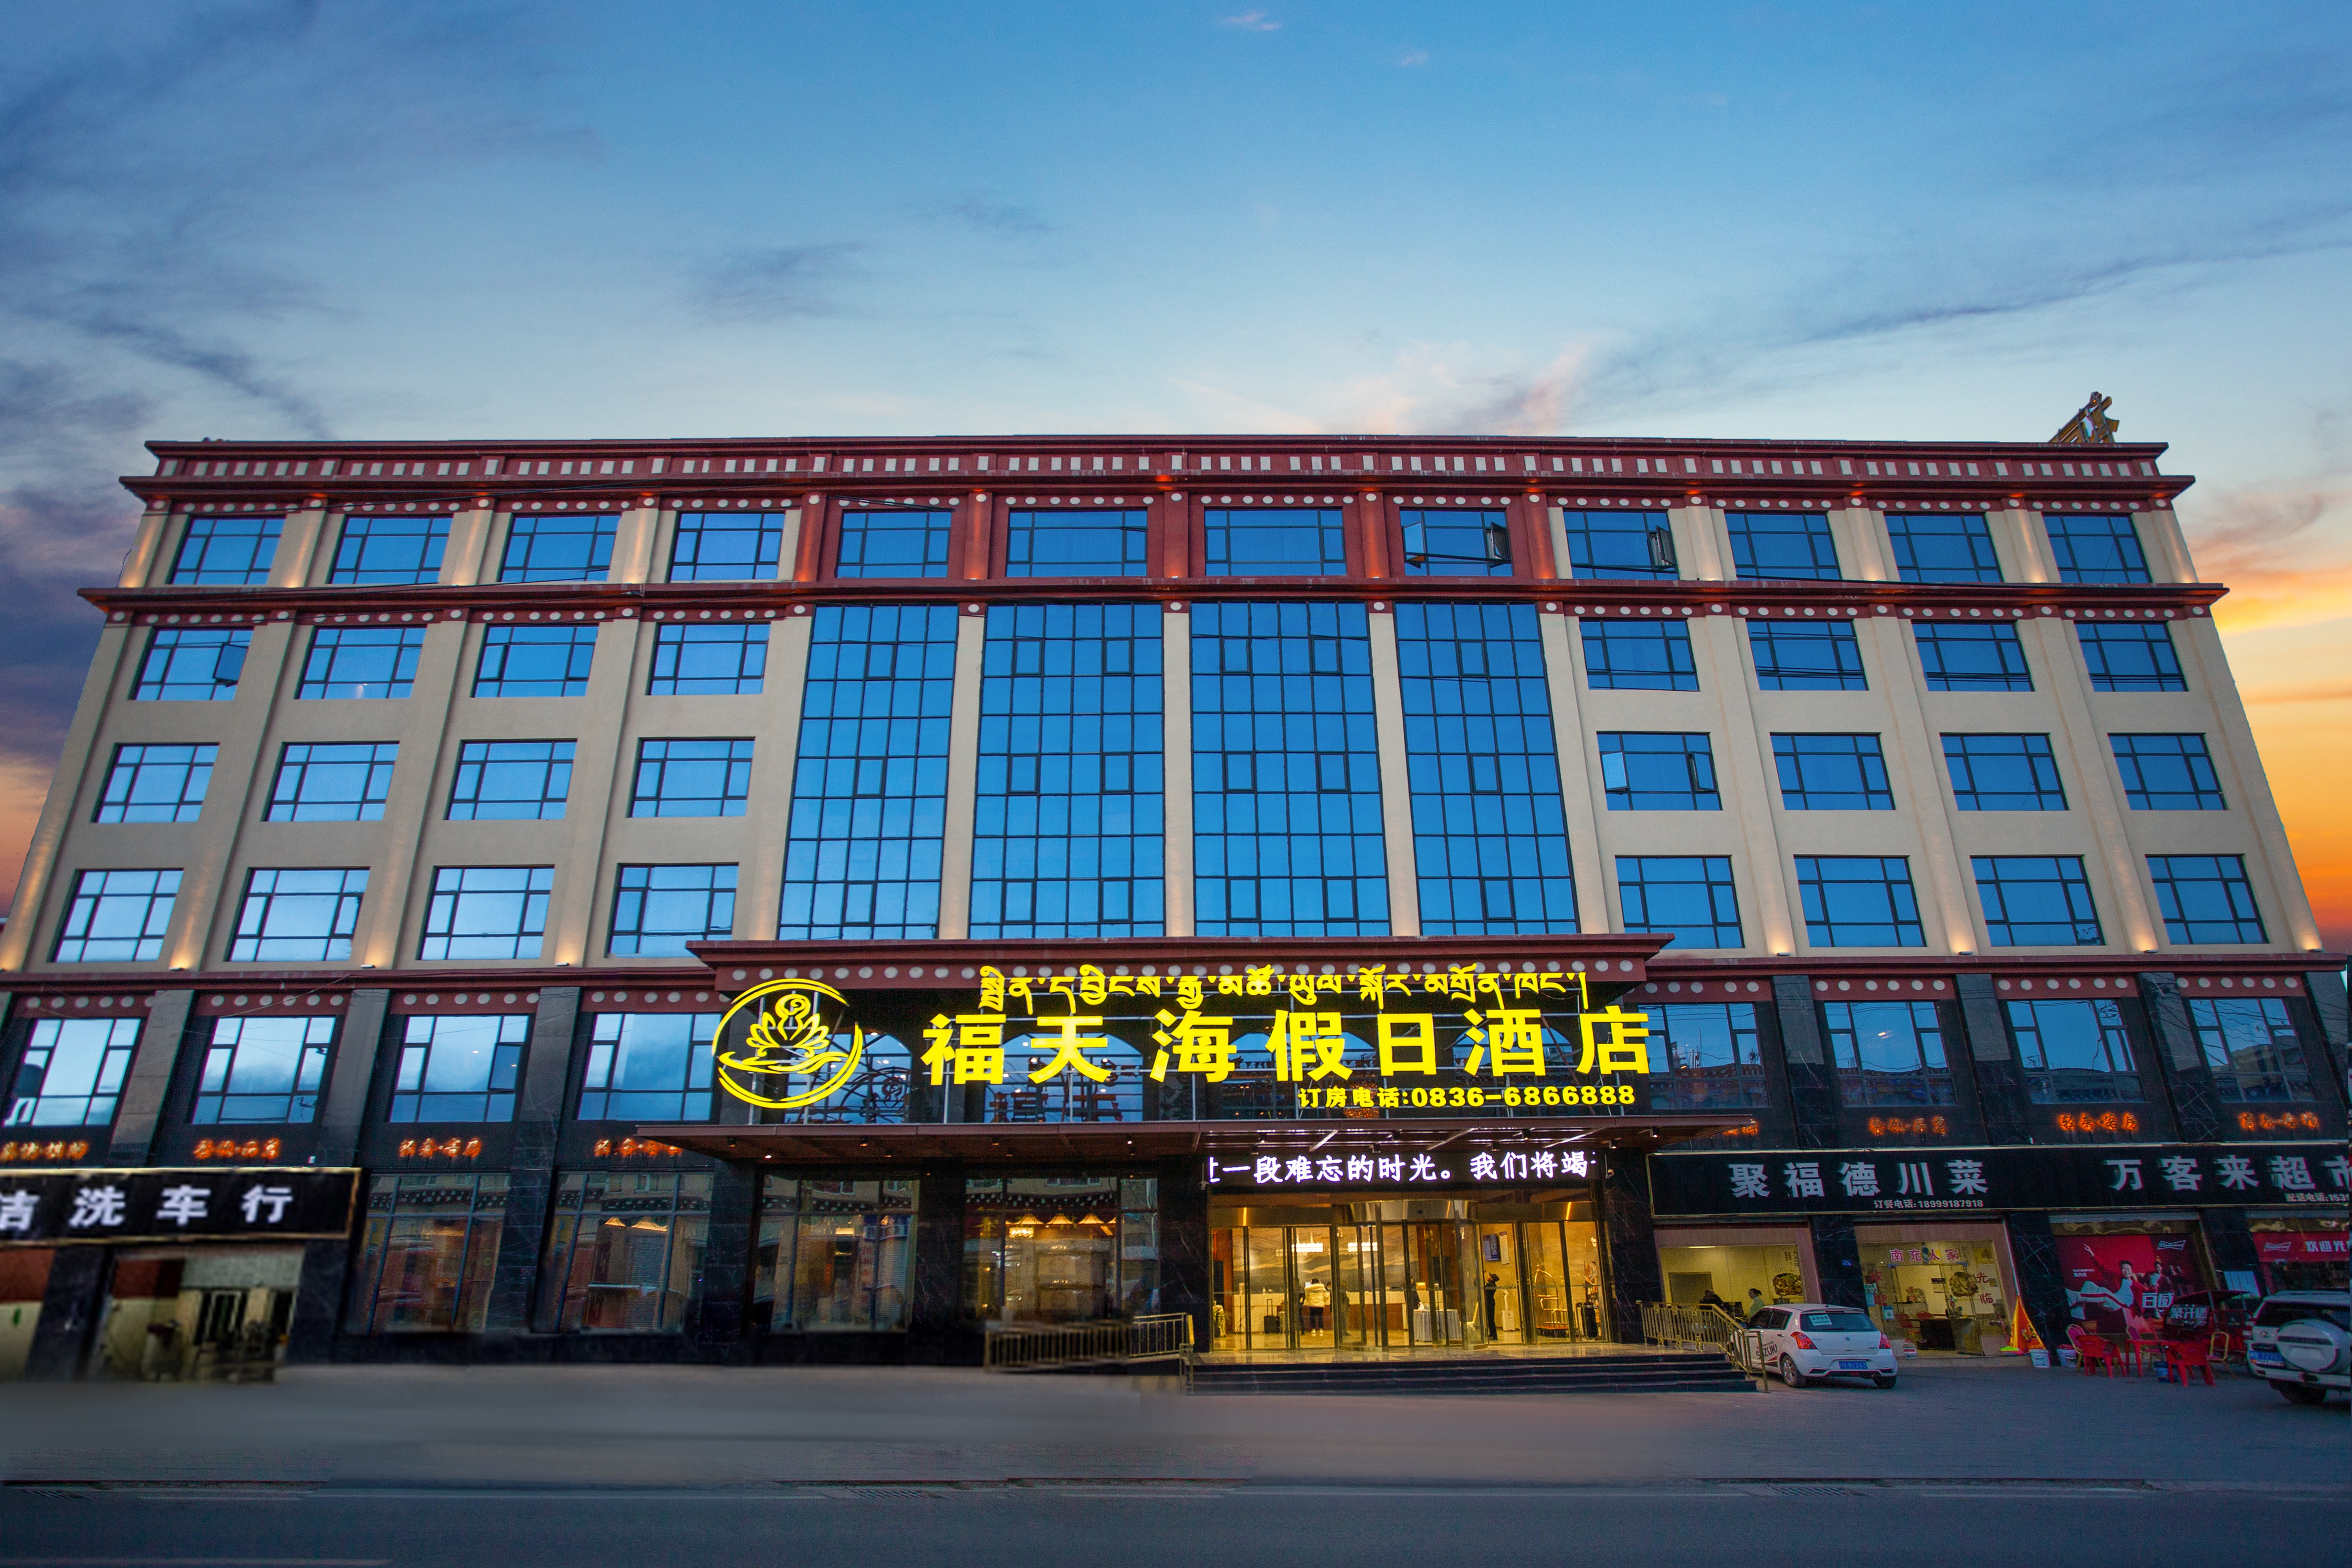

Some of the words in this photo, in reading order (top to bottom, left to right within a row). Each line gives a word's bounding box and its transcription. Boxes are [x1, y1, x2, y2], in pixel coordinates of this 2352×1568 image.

[921, 1006, 1650, 1086] 福天海假日酒店
[1729, 1159, 1989, 1199] 聚福德川菜
[2305, 1240, 2349, 1252] 欢迎光
[1889, 1248, 1960, 1262] 南充人家
[2142, 1292, 2174, 1308] 百威
[1756, 1343, 1777, 1359] SZUKI
